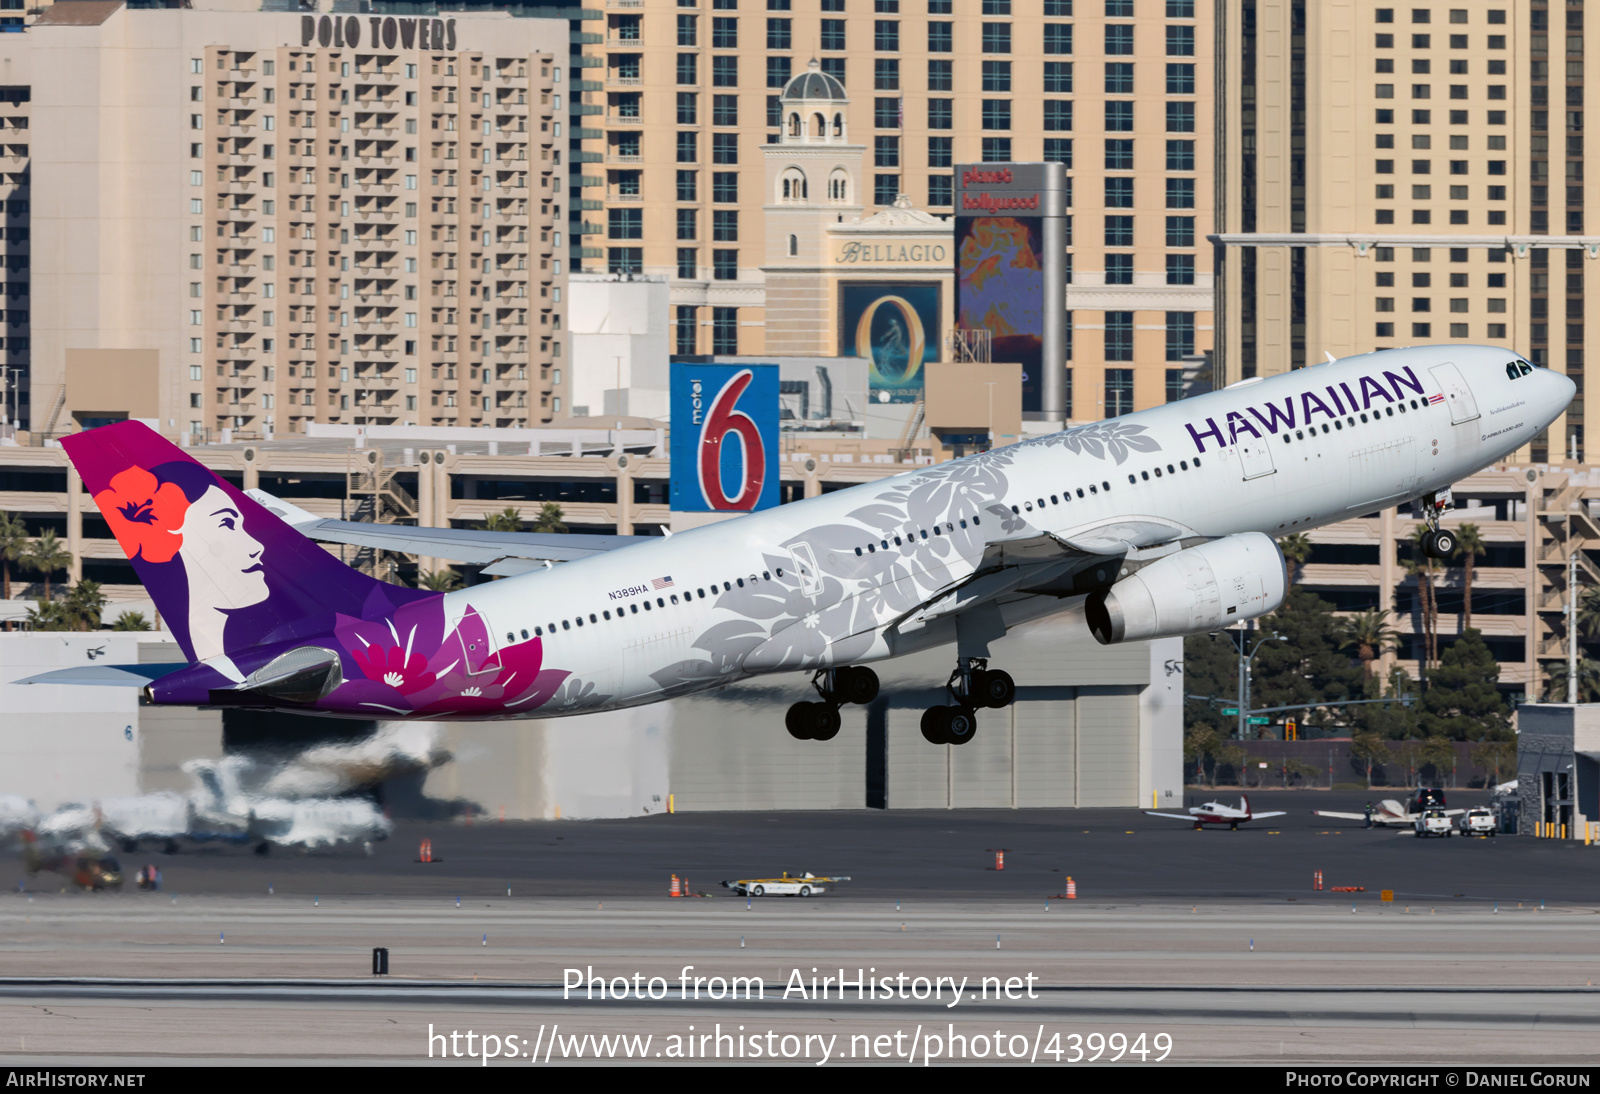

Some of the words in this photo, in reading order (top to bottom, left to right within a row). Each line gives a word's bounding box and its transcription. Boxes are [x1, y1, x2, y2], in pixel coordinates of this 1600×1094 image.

[301, 15, 361, 49] POLO
[369, 16, 456, 50] TOWERS
[962, 166, 1014, 188] planet
[962, 192, 1039, 214] hollywood
[690, 379, 702, 425] motel
[1184, 365, 1425, 454] HAWAIIAN
[697, 368, 766, 511] 6
[607, 584, 649, 601] N389HA
